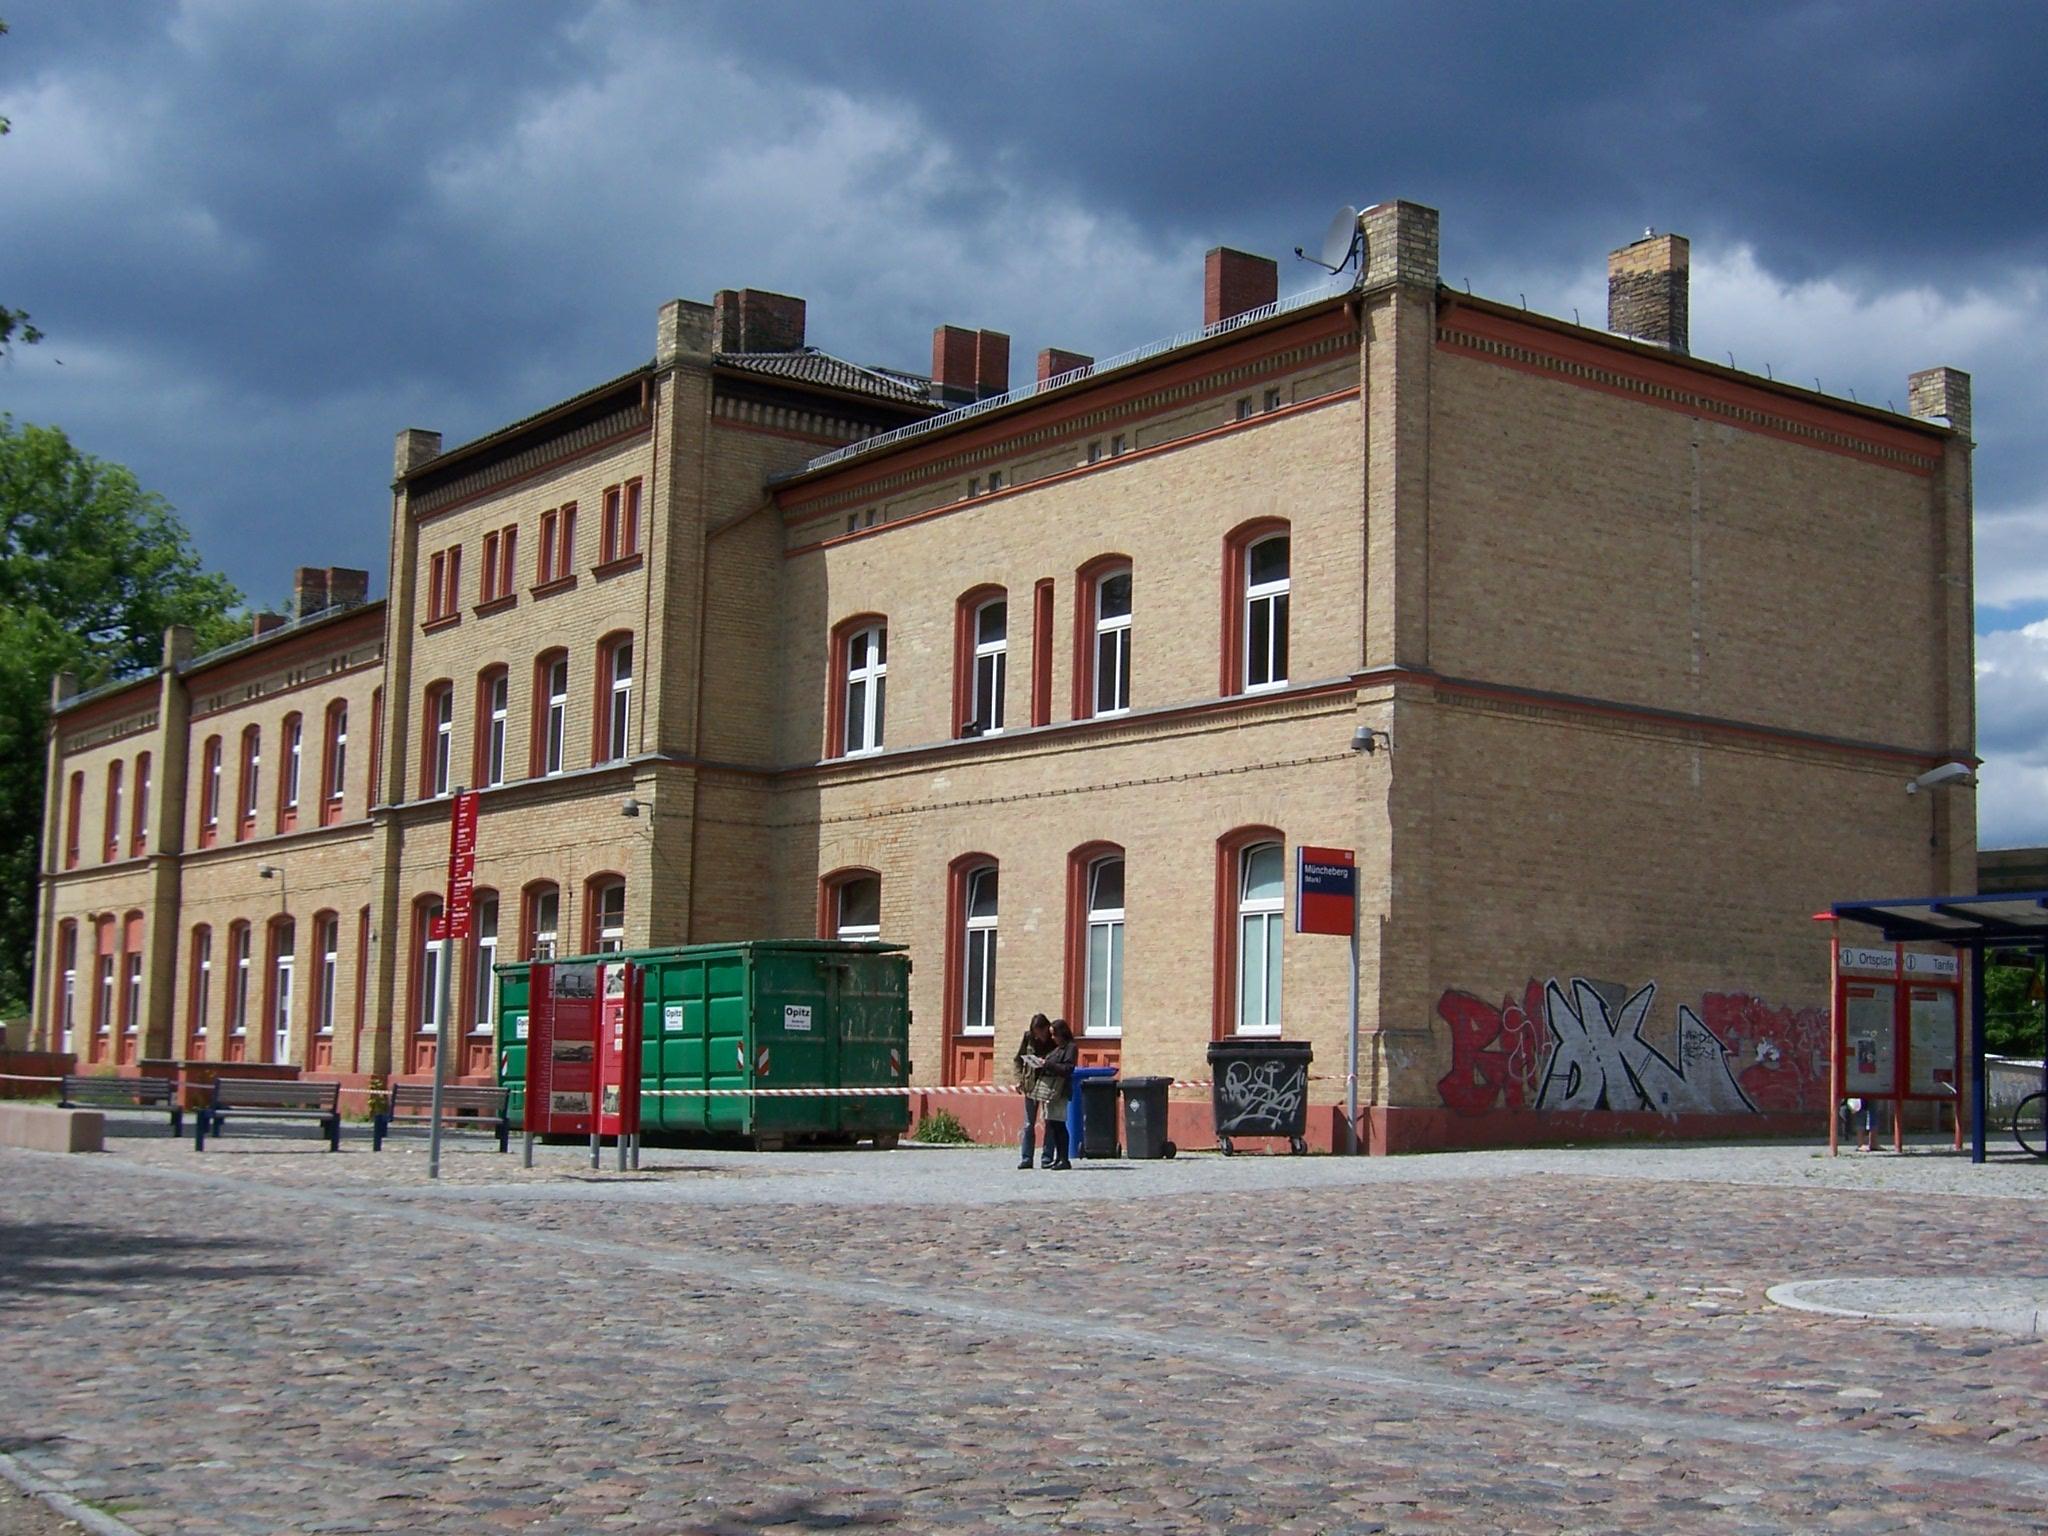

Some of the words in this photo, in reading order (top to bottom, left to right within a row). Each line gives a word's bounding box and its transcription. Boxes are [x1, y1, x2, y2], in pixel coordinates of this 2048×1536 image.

[1304, 864, 1348, 878] Müncheberg
[1859, 952, 1893, 968] Ortsplan
[666, 1009, 682, 1019] Opitz
[786, 1007, 810, 1018] Opitz
